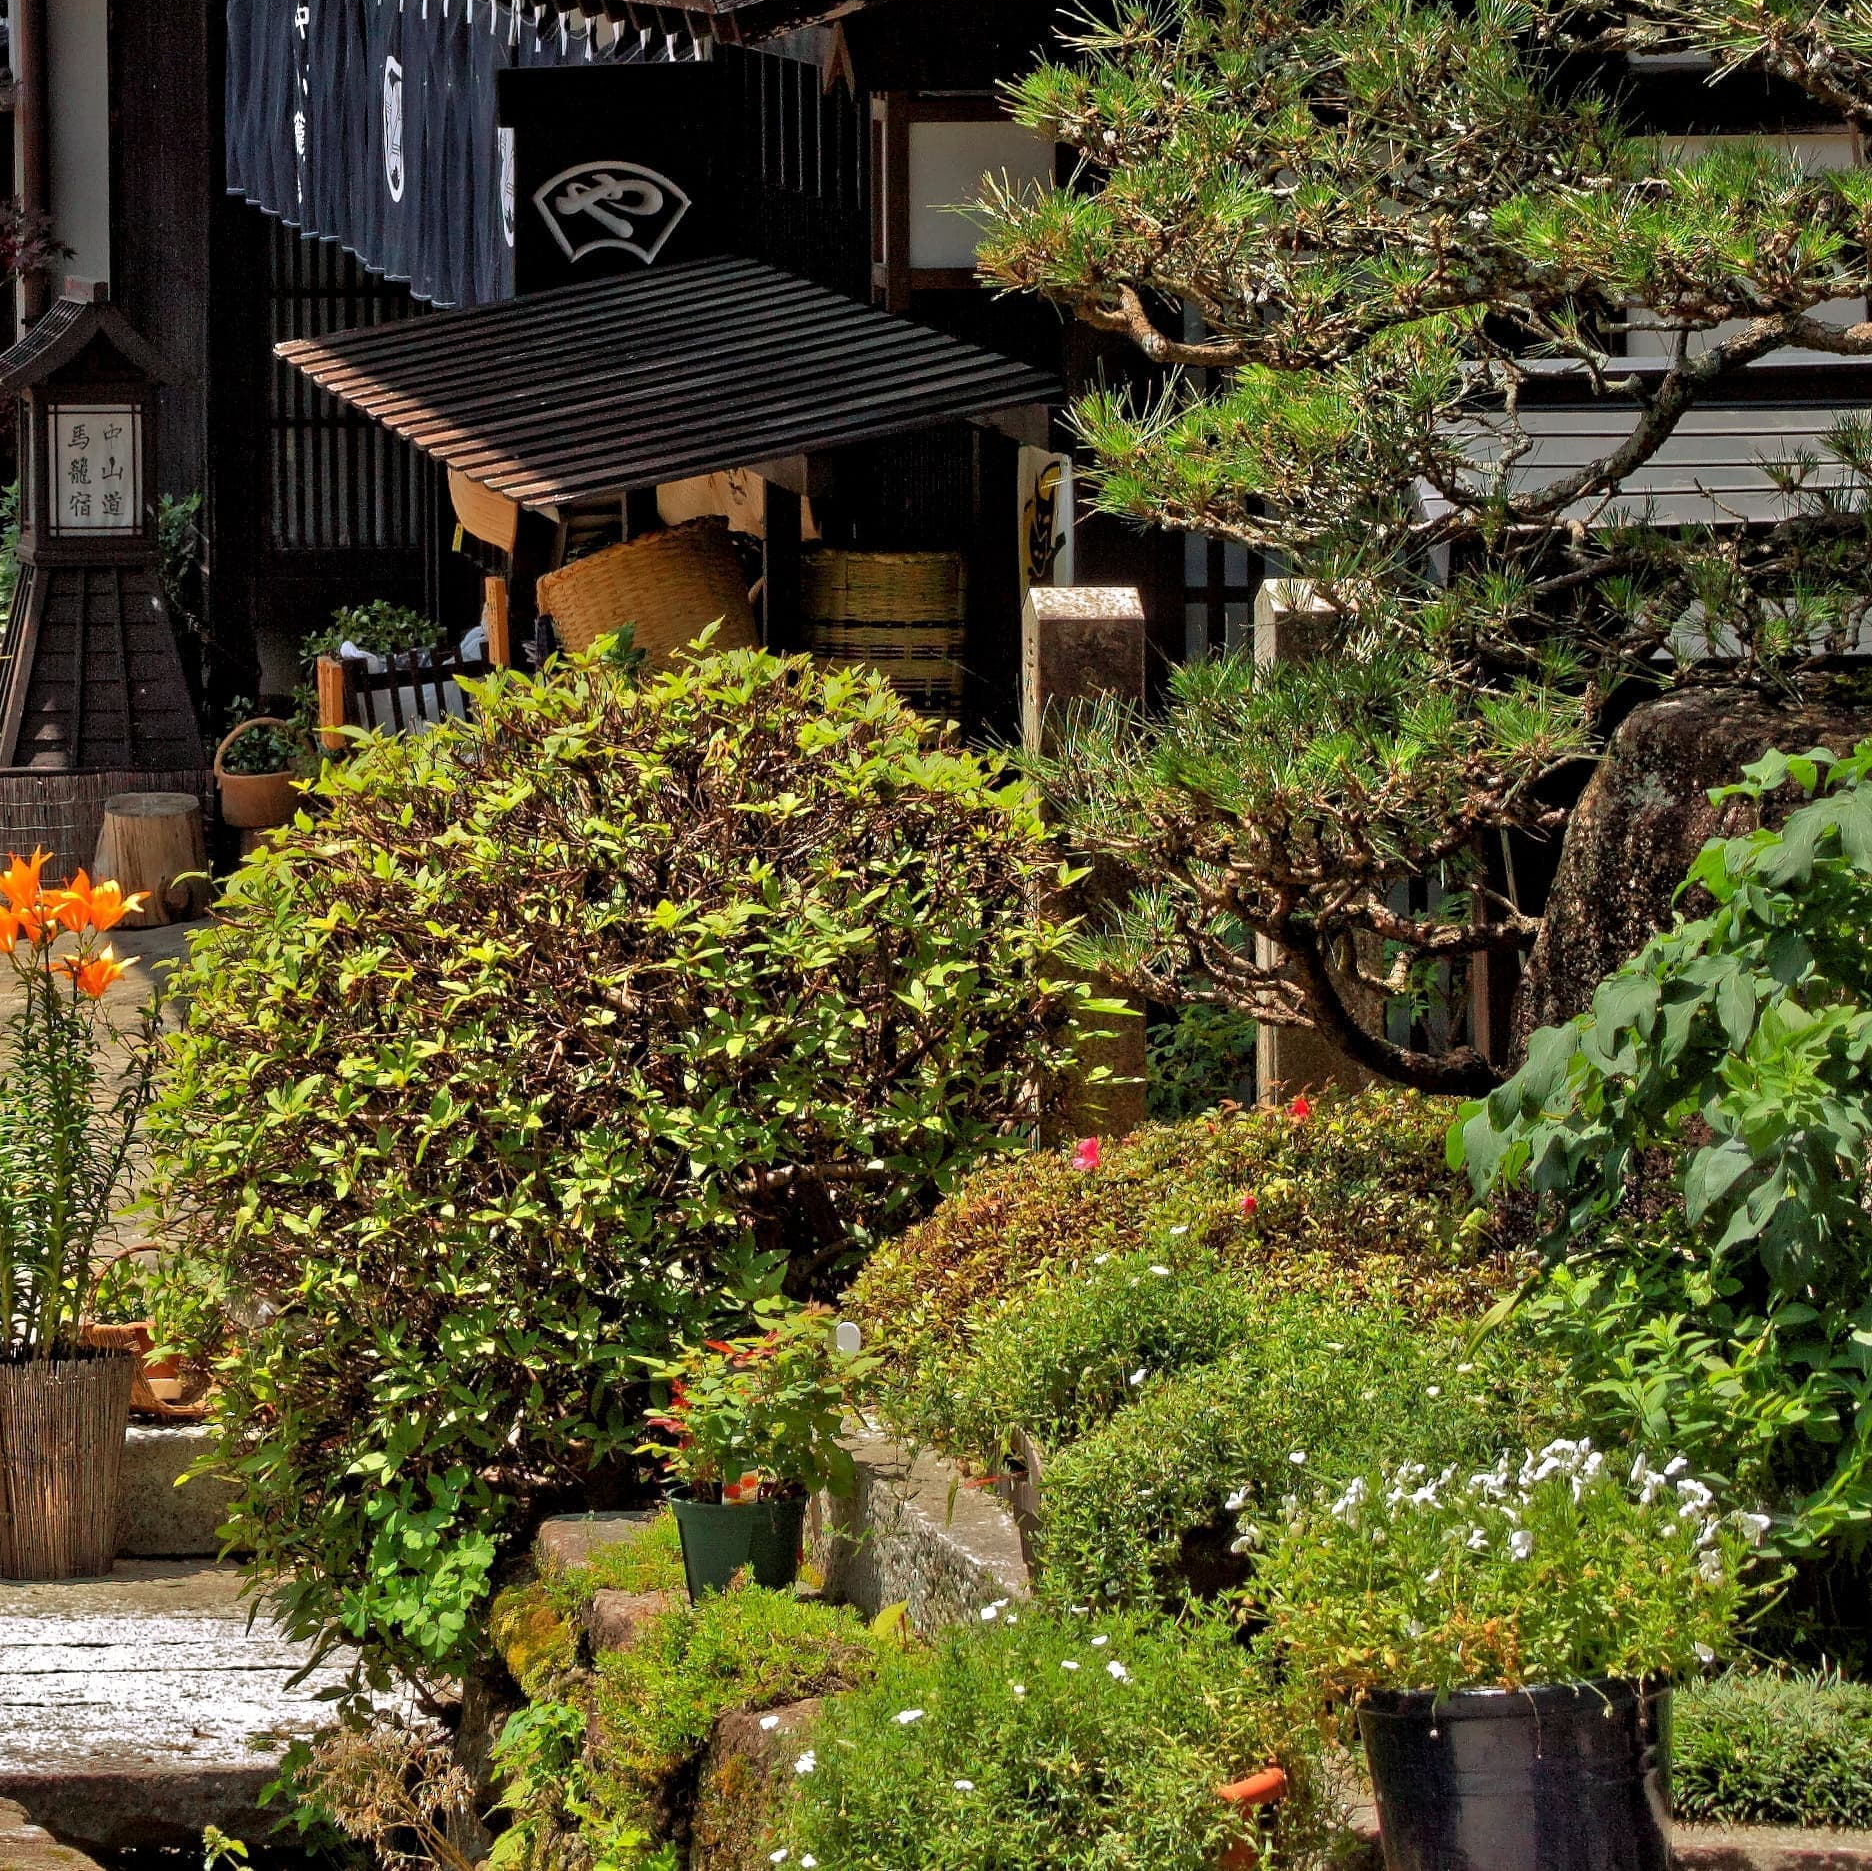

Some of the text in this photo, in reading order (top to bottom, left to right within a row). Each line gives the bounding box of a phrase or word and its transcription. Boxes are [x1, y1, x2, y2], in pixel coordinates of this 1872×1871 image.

[68, 424, 92, 517] 馬籠宿
[101, 423, 125, 516] 中山道
